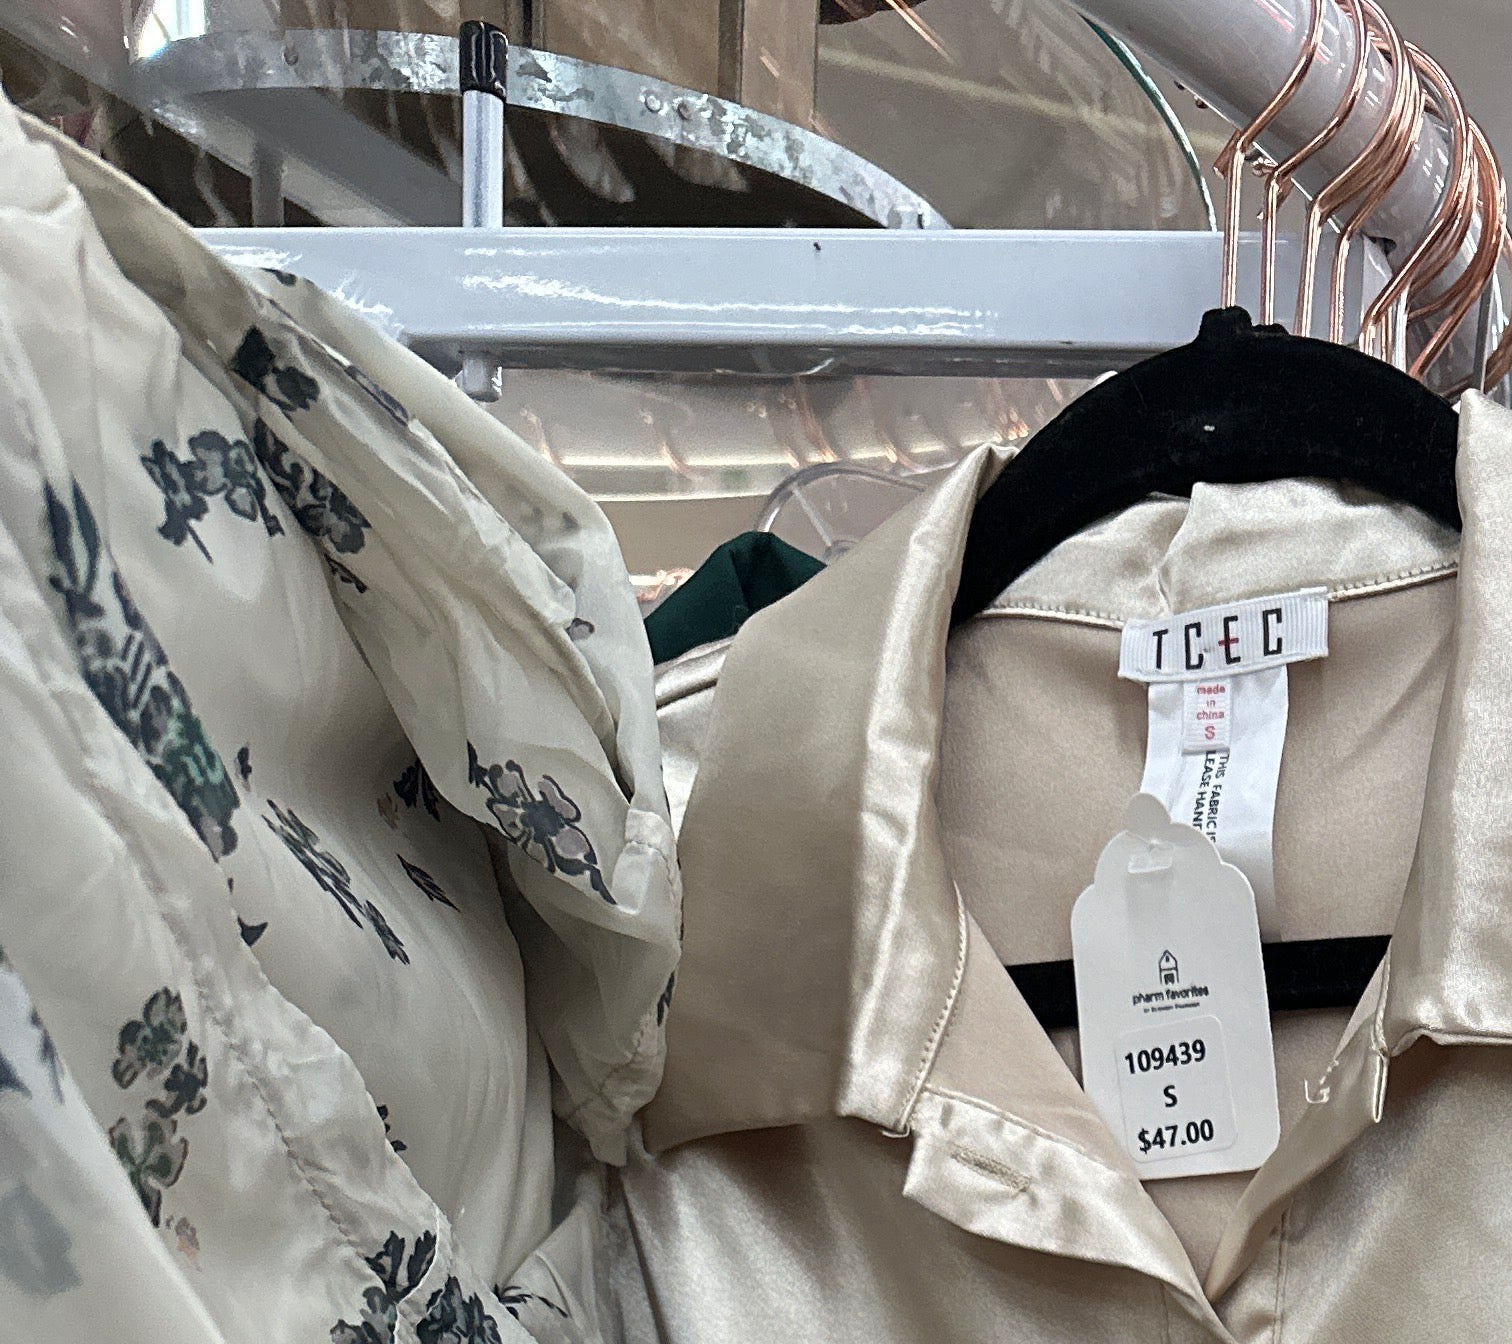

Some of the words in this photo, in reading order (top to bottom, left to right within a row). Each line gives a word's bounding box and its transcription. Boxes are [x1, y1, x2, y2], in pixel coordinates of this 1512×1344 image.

[1153, 608, 1283, 670] TCEC
[1196, 684, 1226, 695] made
[1196, 710, 1225, 720] china
[1206, 699, 1216, 708] in
[1204, 725, 1216, 740] S
[1199, 750, 1217, 789] LEASE
[1215, 753, 1230, 779] THIS
[1206, 784, 1222, 829] FABRIC
[1132, 992, 1165, 1006] pharm
[1165, 984, 1210, 1001] favorites
[1125, 1038, 1206, 1075] 109439
[1163, 1084, 1178, 1108] S
[1138, 1118, 1214, 1155] $47.00
